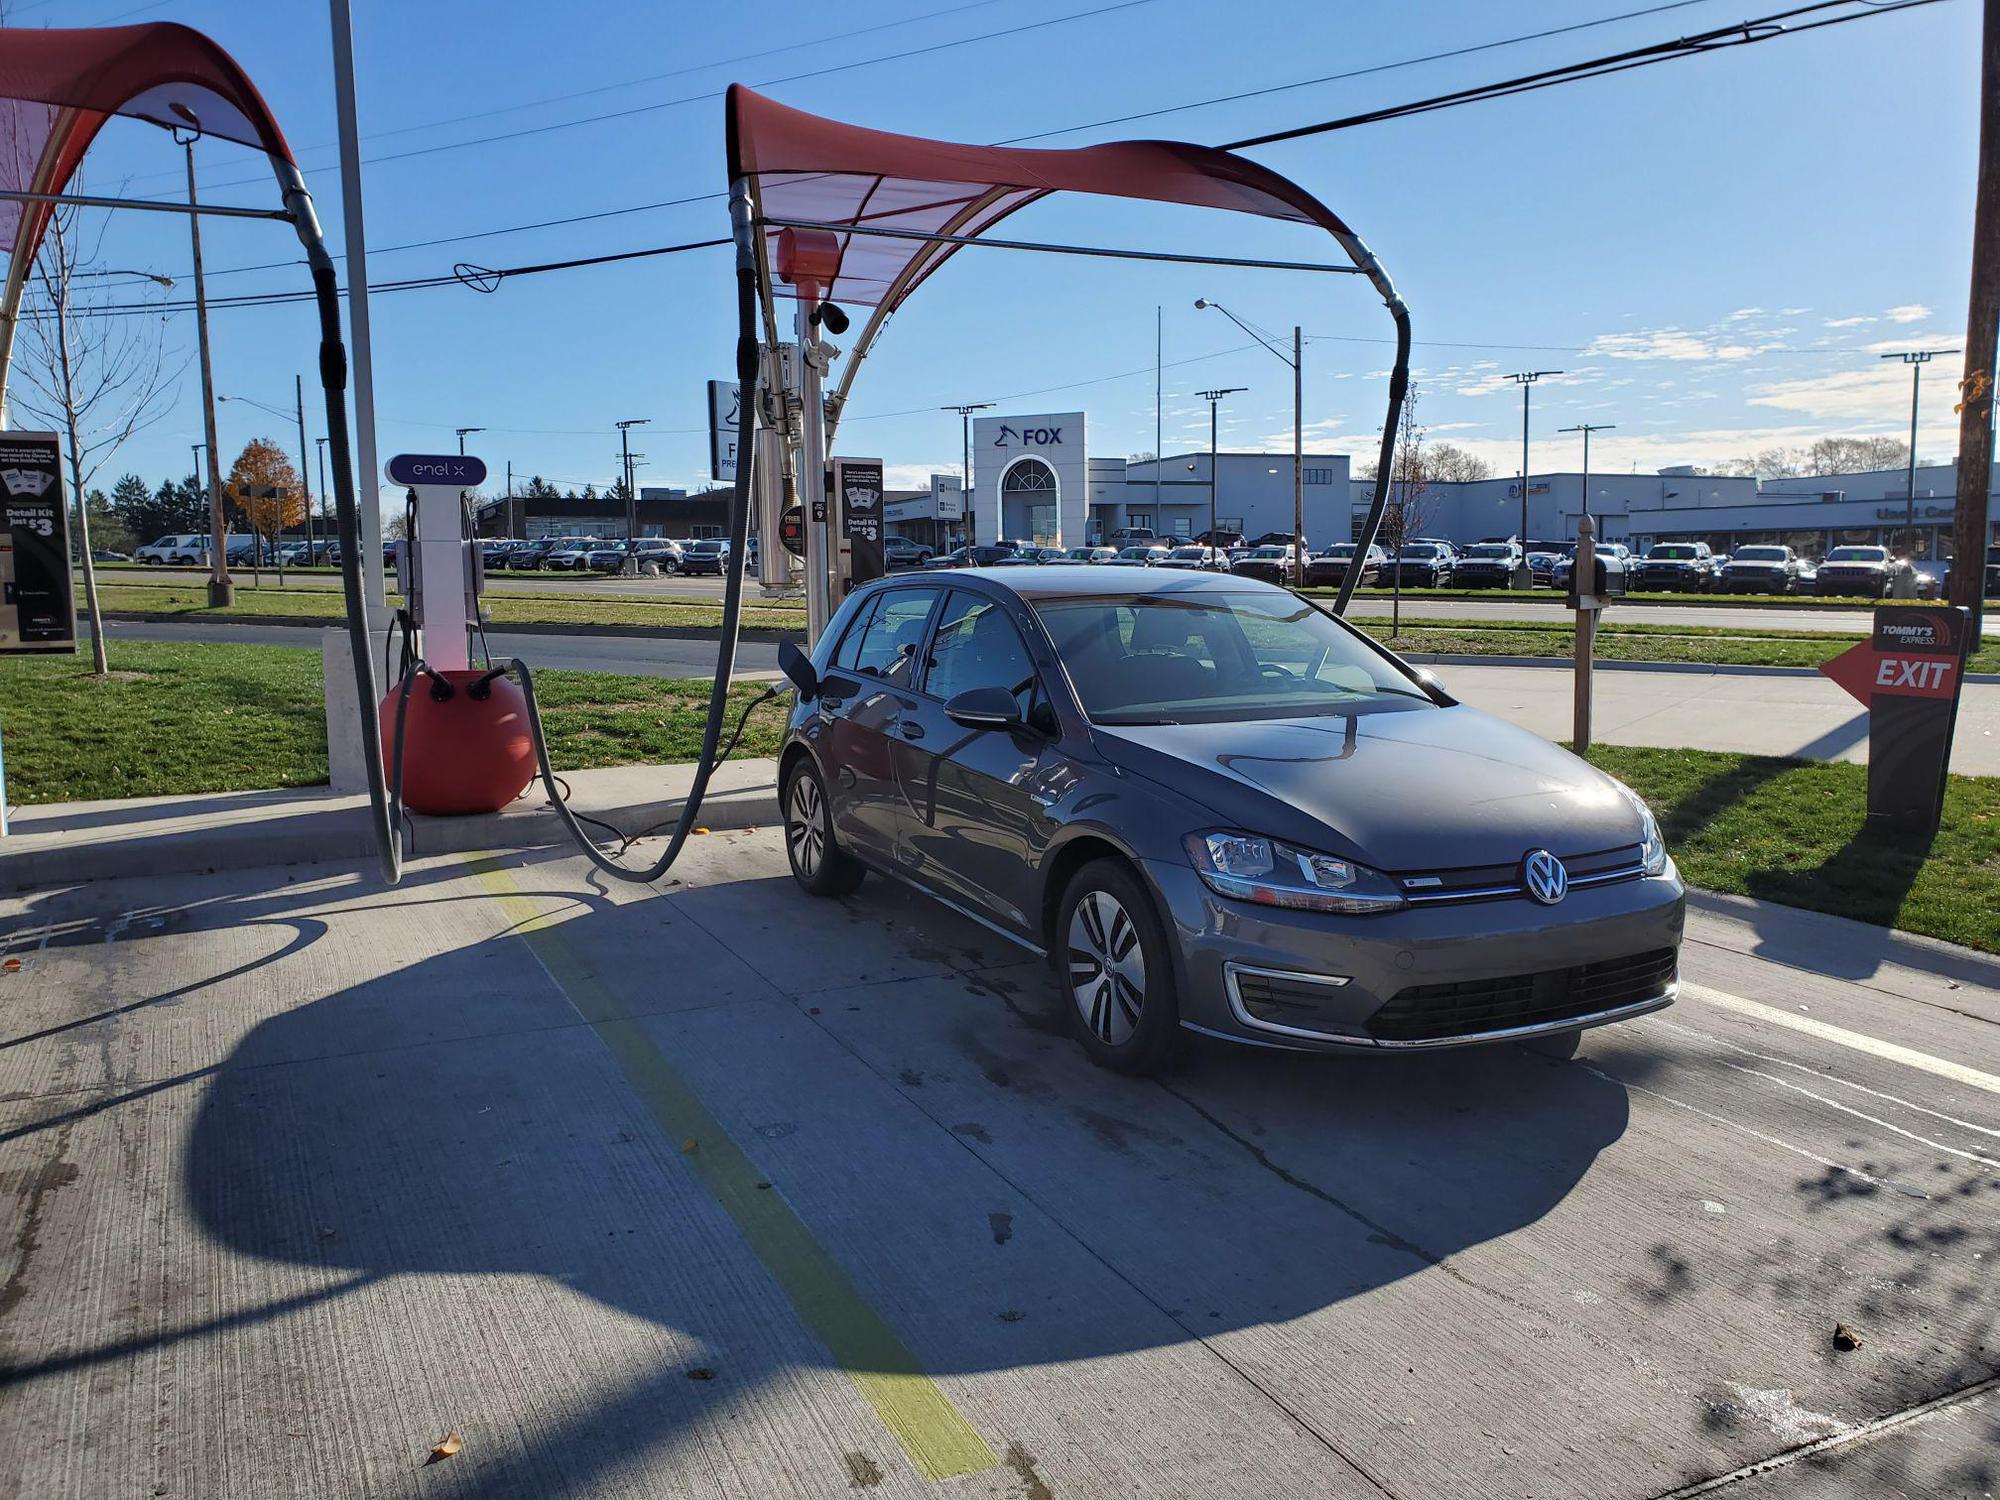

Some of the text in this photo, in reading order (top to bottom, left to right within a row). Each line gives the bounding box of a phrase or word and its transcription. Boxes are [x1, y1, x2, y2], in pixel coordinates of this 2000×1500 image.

[1023, 427, 1063, 446] FOX
[728, 443, 736, 458] F
[412, 462, 450, 476] enel
[721, 459, 737, 468] PRE
[6, 508, 54, 517] Detail Kit
[10, 516, 27, 527] just
[848, 518, 867, 526] Detail
[1882, 625, 1934, 637] TOMMY'S
[1900, 635, 1936, 645] EXPRESS
[1876, 659, 1952, 689] EXIT
